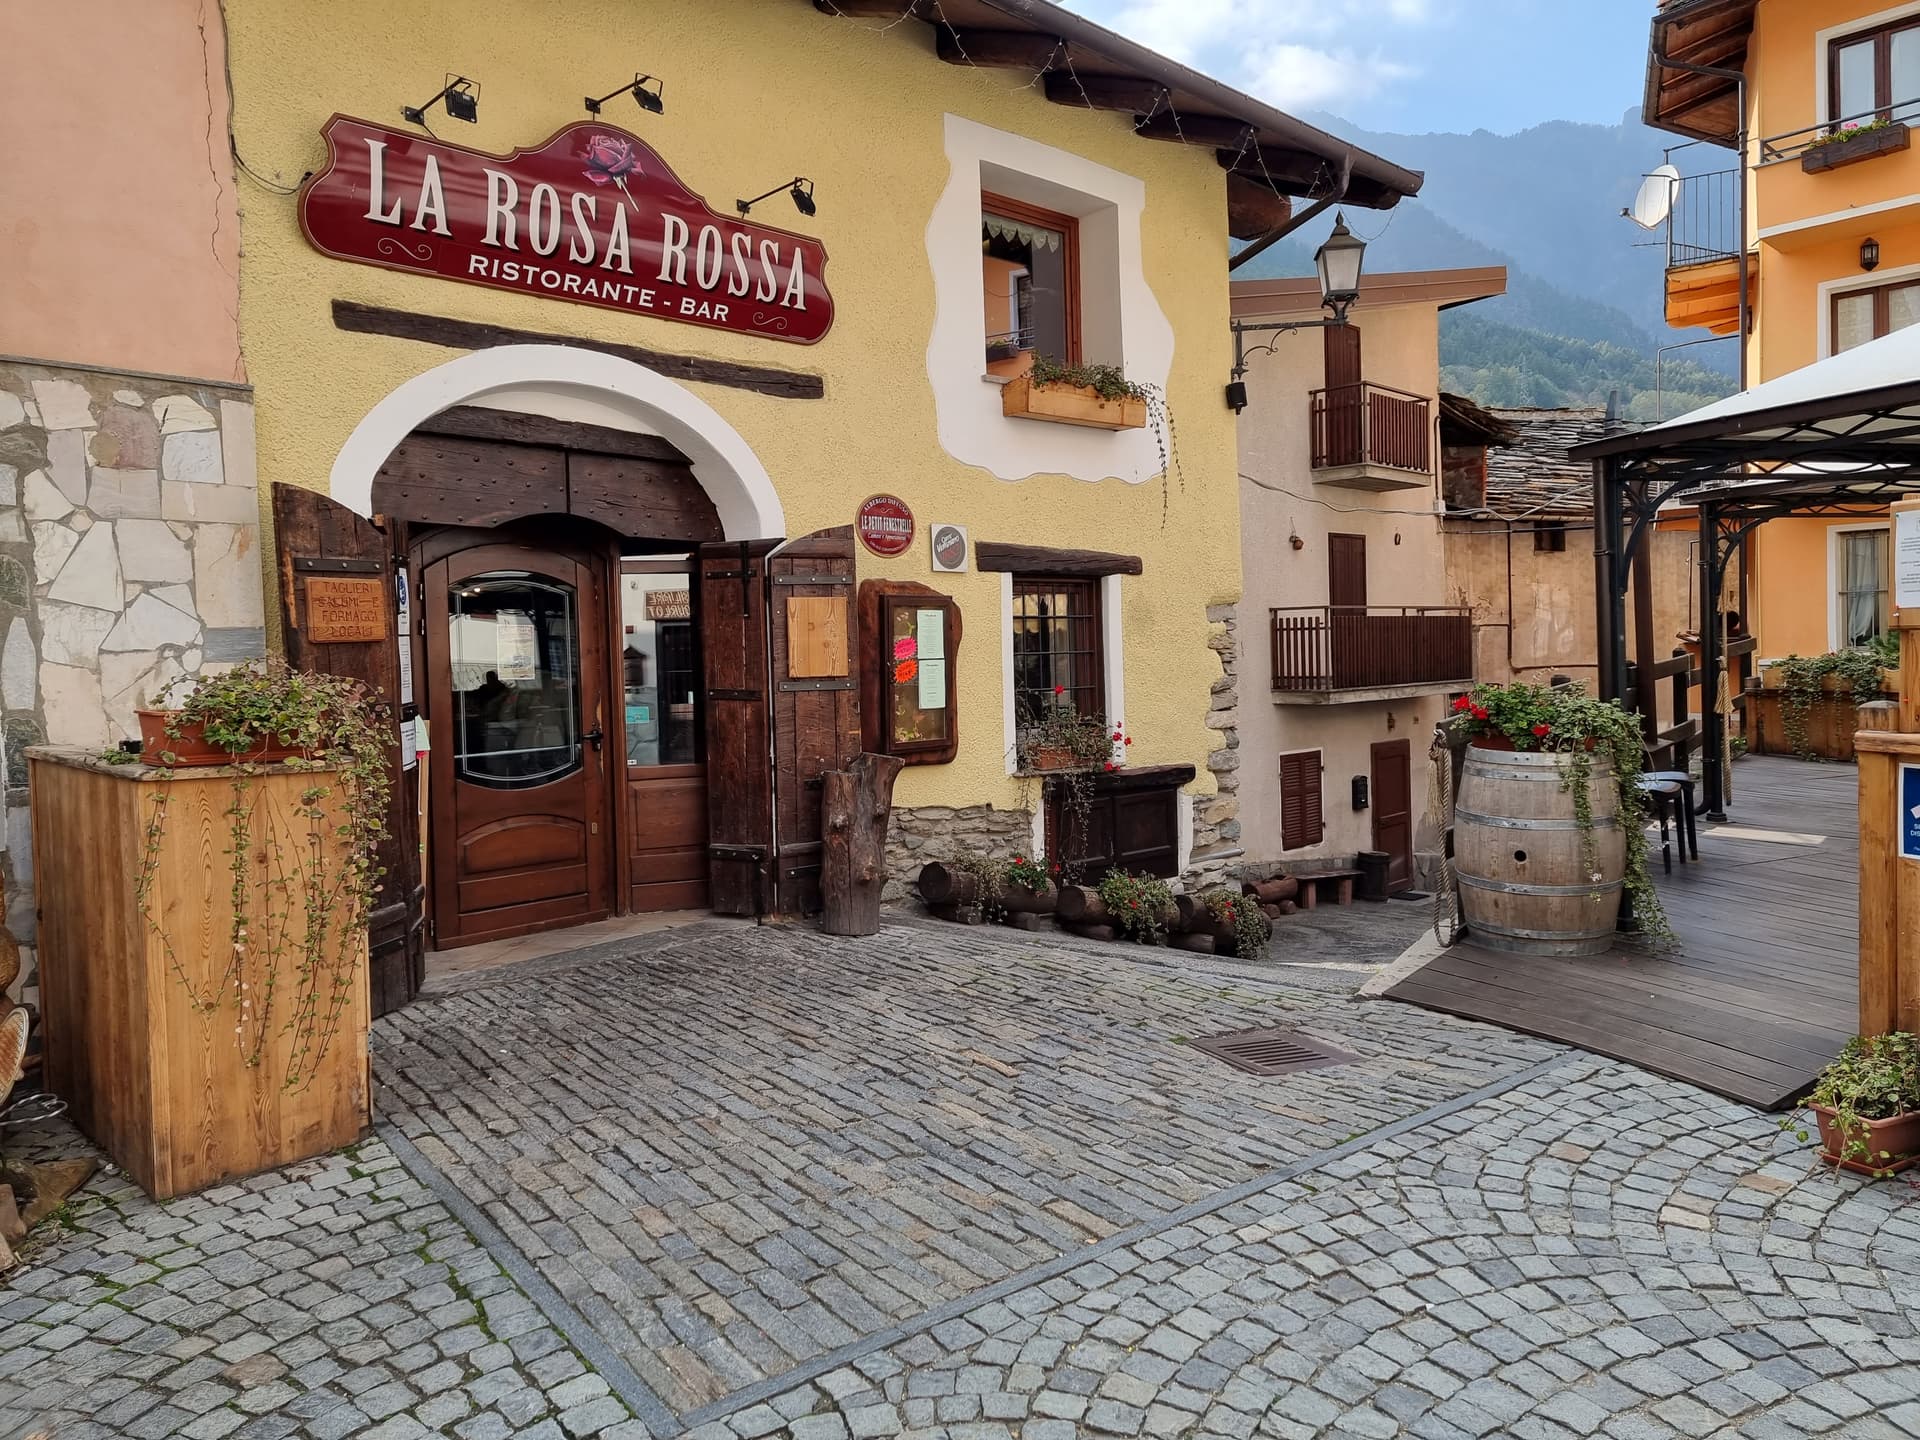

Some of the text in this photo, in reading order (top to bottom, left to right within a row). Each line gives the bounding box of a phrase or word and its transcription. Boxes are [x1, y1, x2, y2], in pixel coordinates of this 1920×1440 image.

[363, 137, 808, 312] LA ROSA ROSSA
[468, 254, 655, 309] RISTORANTE
[680, 298, 730, 323] BAR
[863, 497, 887, 513] ALBERGO
[861, 515, 912, 533] LE PETIT FENESTRELLE
[323, 581, 373, 594] TAGLIERI
[318, 596, 360, 608] SALUMI
[322, 610, 378, 622] FORMAGGI
[331, 625, 374, 638] LOCALI
